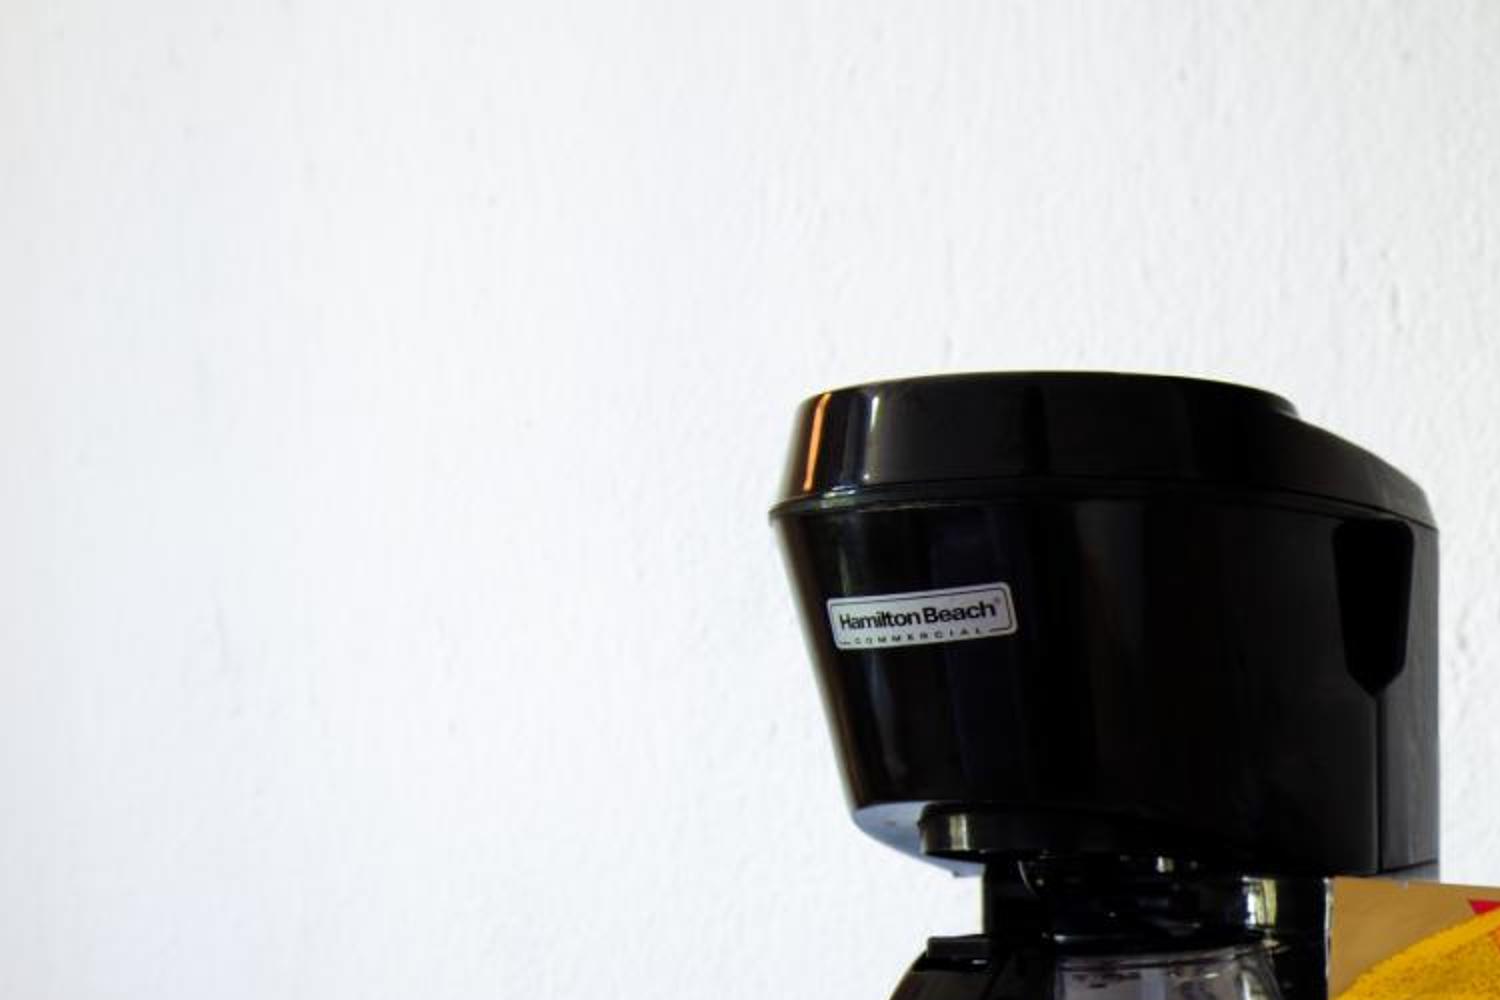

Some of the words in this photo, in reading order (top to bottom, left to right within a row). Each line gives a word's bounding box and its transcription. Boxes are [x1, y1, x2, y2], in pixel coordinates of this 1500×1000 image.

[838, 610, 921, 630] Hamilton
[921, 601, 996, 624] Beach
[854, 626, 982, 645] COMMERCIAL
